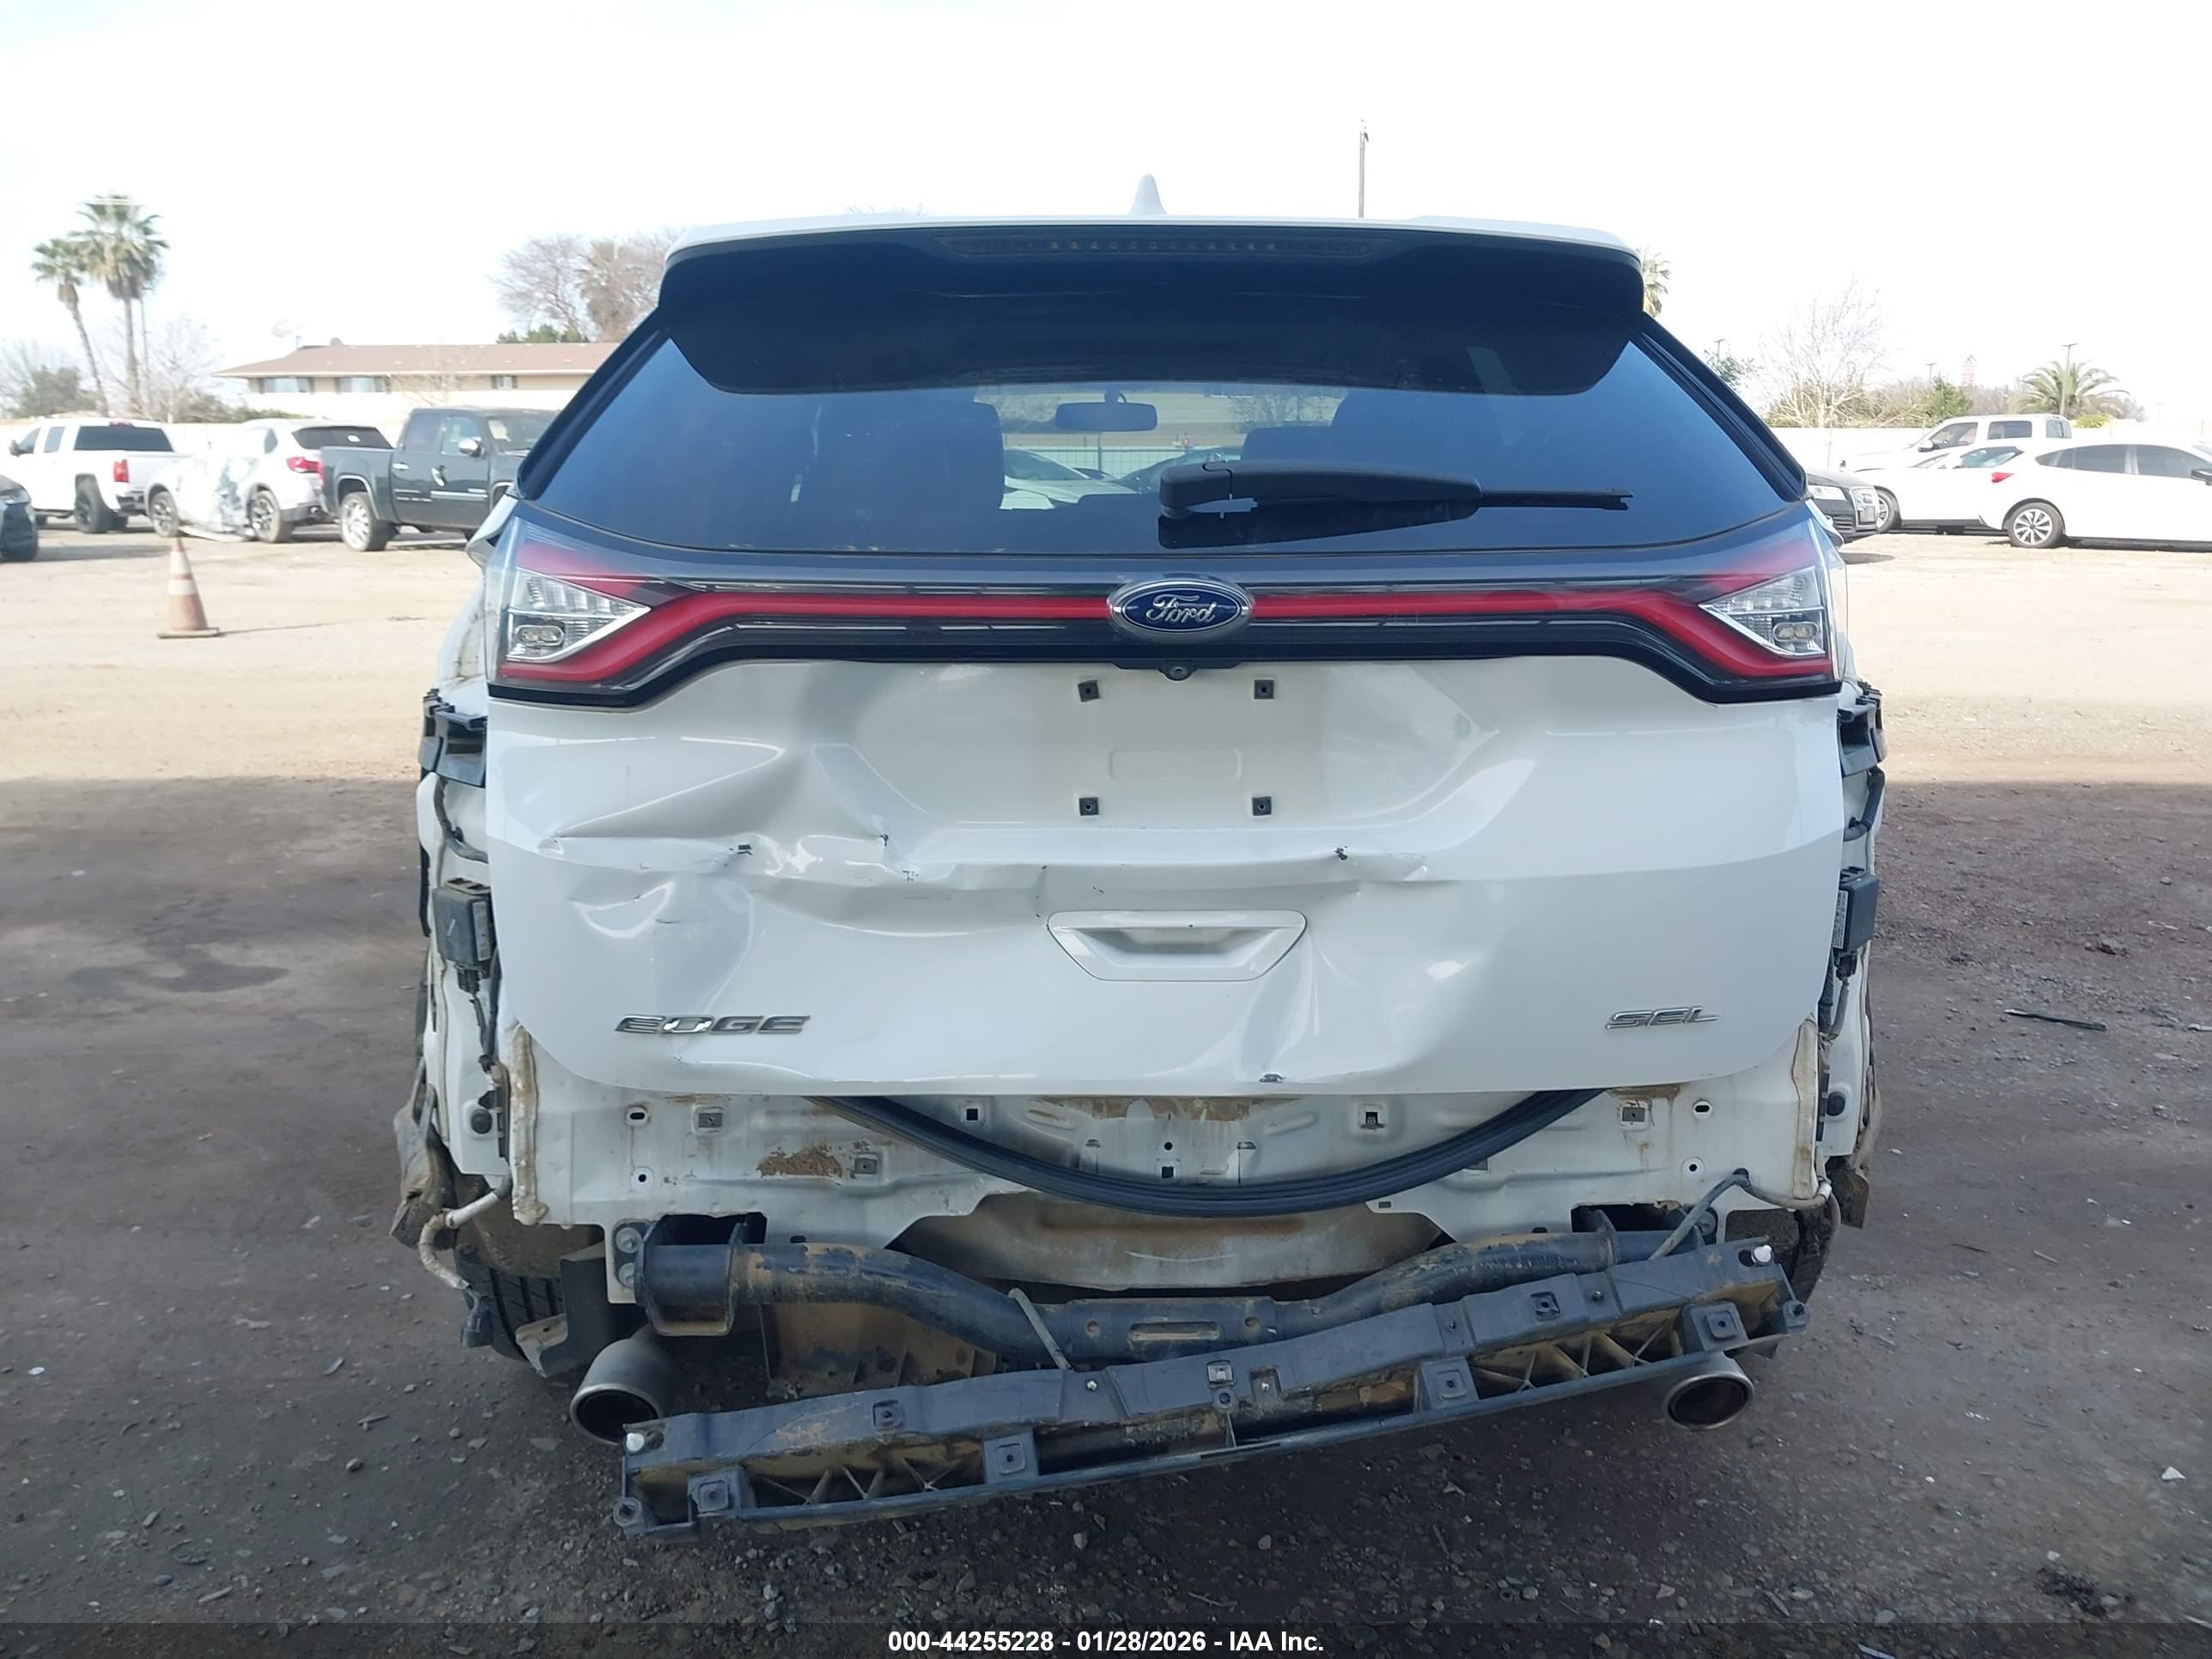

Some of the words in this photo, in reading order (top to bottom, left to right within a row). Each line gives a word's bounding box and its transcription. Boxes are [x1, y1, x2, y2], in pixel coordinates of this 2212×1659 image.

[1146, 593, 1217, 624] Ford
[615, 1014, 811, 1035] EDGE
[1605, 1006, 1720, 1030] SEL
